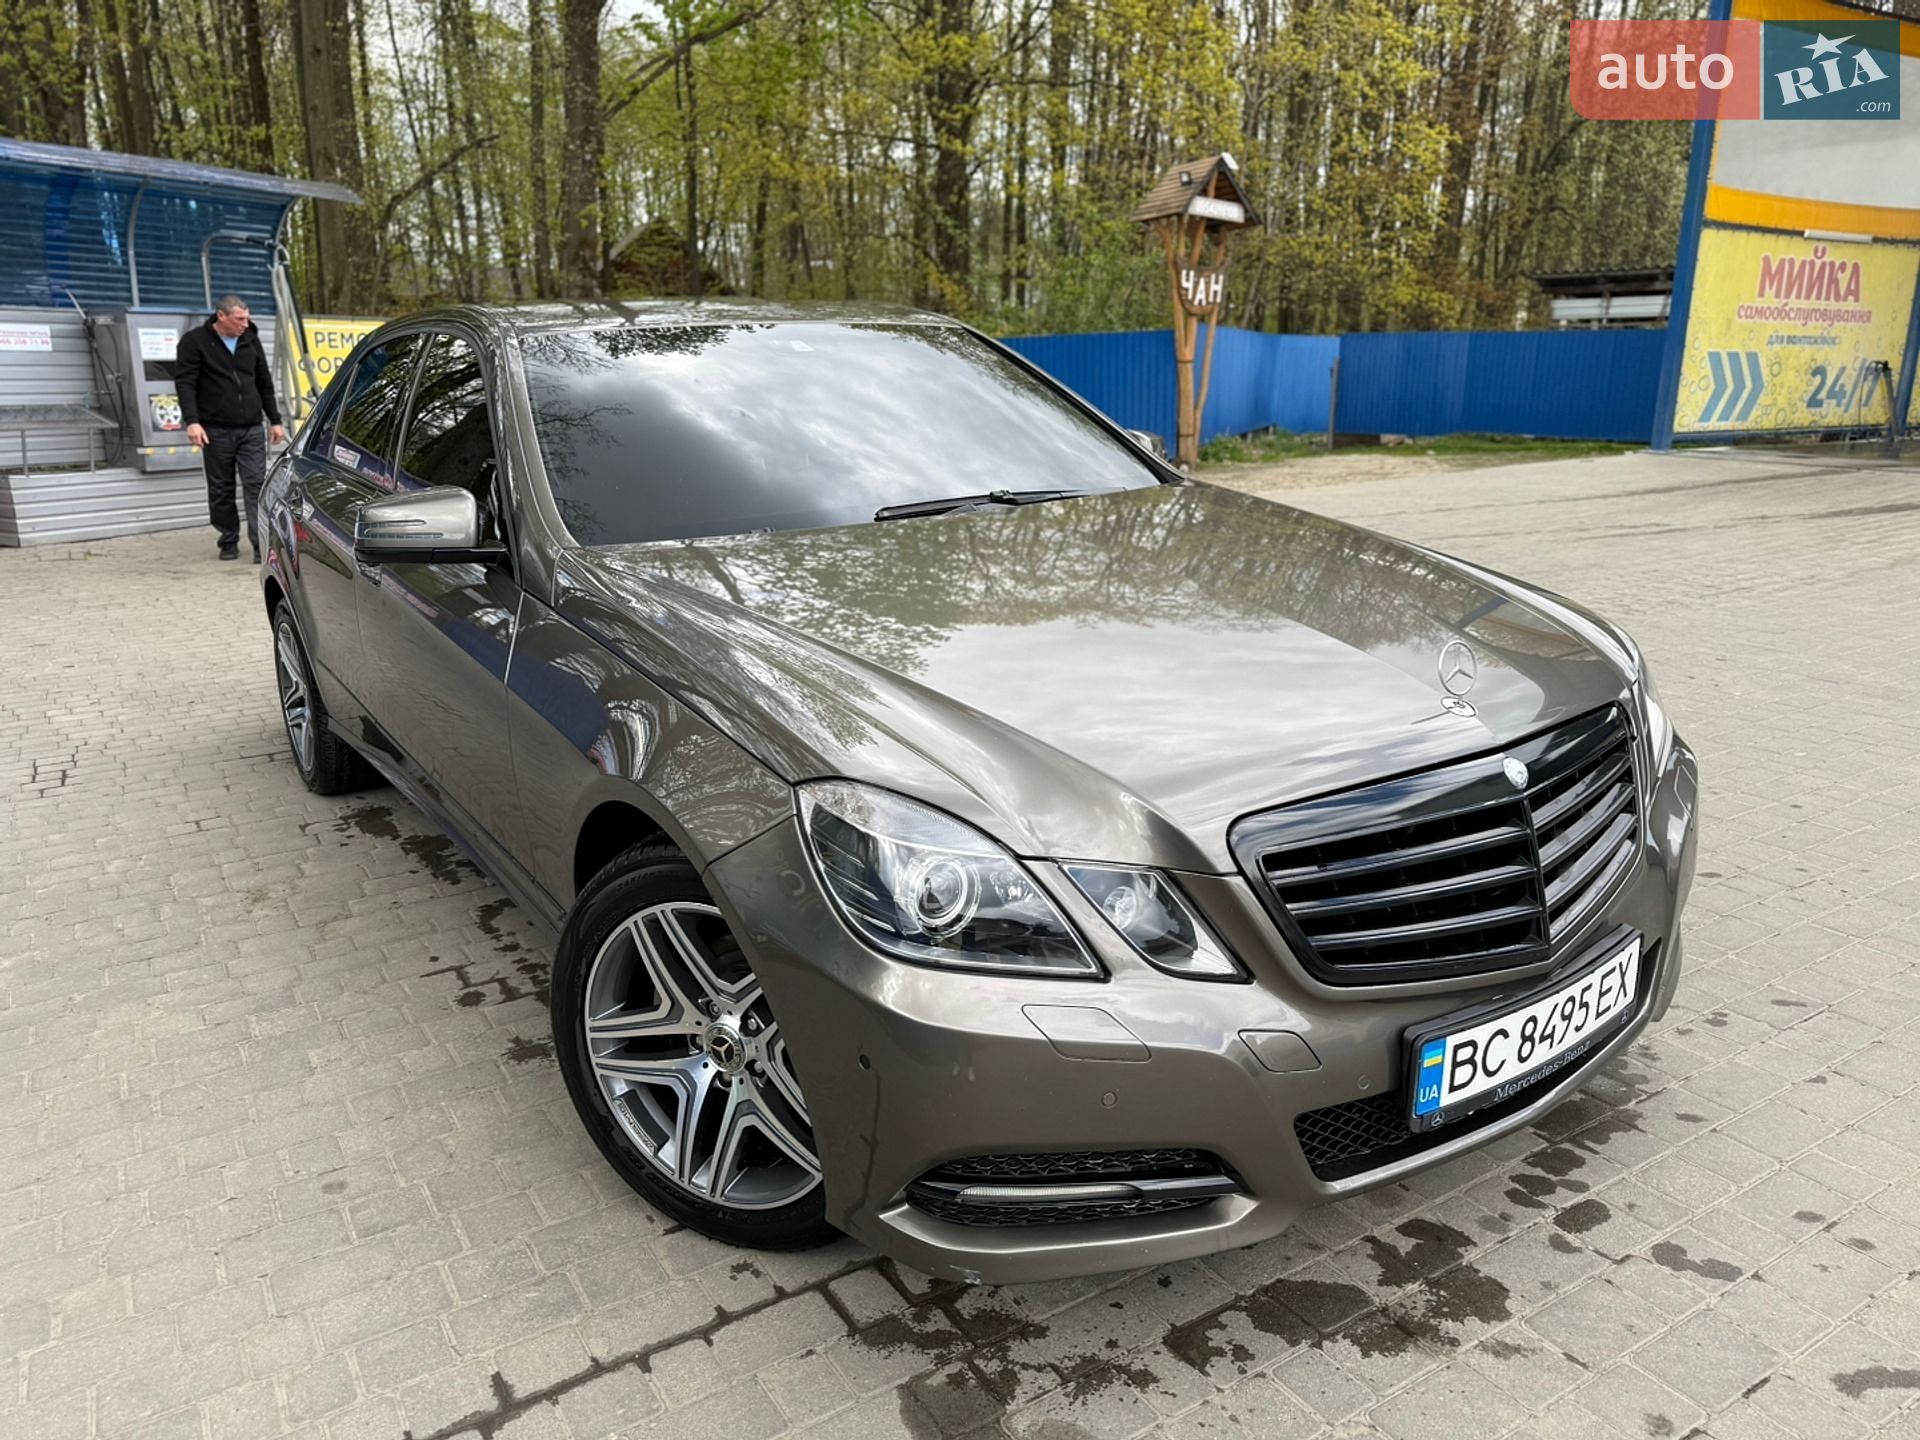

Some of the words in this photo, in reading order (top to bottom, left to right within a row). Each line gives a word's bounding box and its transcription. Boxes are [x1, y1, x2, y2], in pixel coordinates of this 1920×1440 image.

[1181, 269, 1223, 306] ЧАН
[1757, 245, 1861, 303] МИЙКА
[1737, 302, 1872, 326] самообслуговування
[1806, 358, 1883, 413] 24/7
[1448, 1028, 1510, 1094] BC
[1517, 983, 1593, 1064] 8495
[1594, 952, 1633, 1020] EX
[1419, 1087, 1439, 1103] UA
